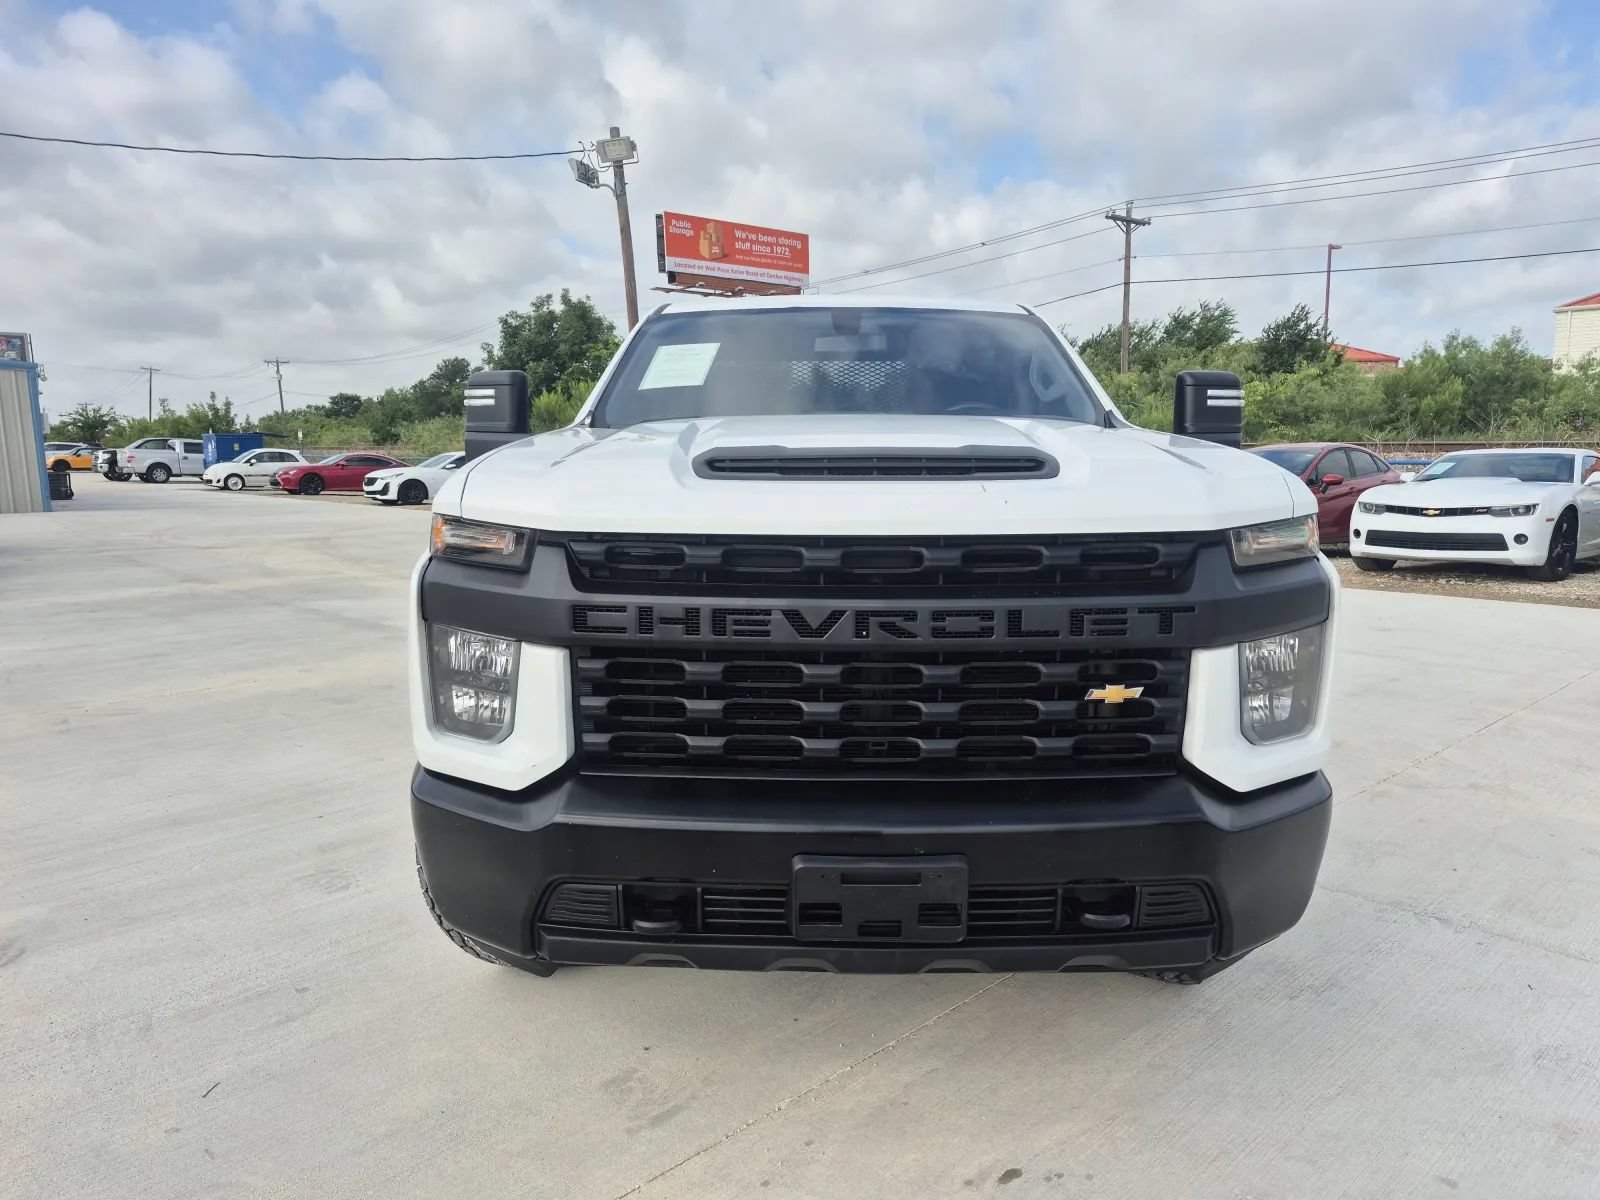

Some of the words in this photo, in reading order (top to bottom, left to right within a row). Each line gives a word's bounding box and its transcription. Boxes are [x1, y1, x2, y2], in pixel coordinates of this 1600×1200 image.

[672, 219, 692, 228] Public
[669, 225, 694, 237] Storage
[734, 228, 757, 240] We've
[758, 232, 777, 244] been
[778, 236, 802, 249] storing
[735, 241, 751, 250] stuff
[751, 243, 771, 253] since
[674, 261, 696, 270] Located
[571, 604, 1196, 640] CHEVROLET
